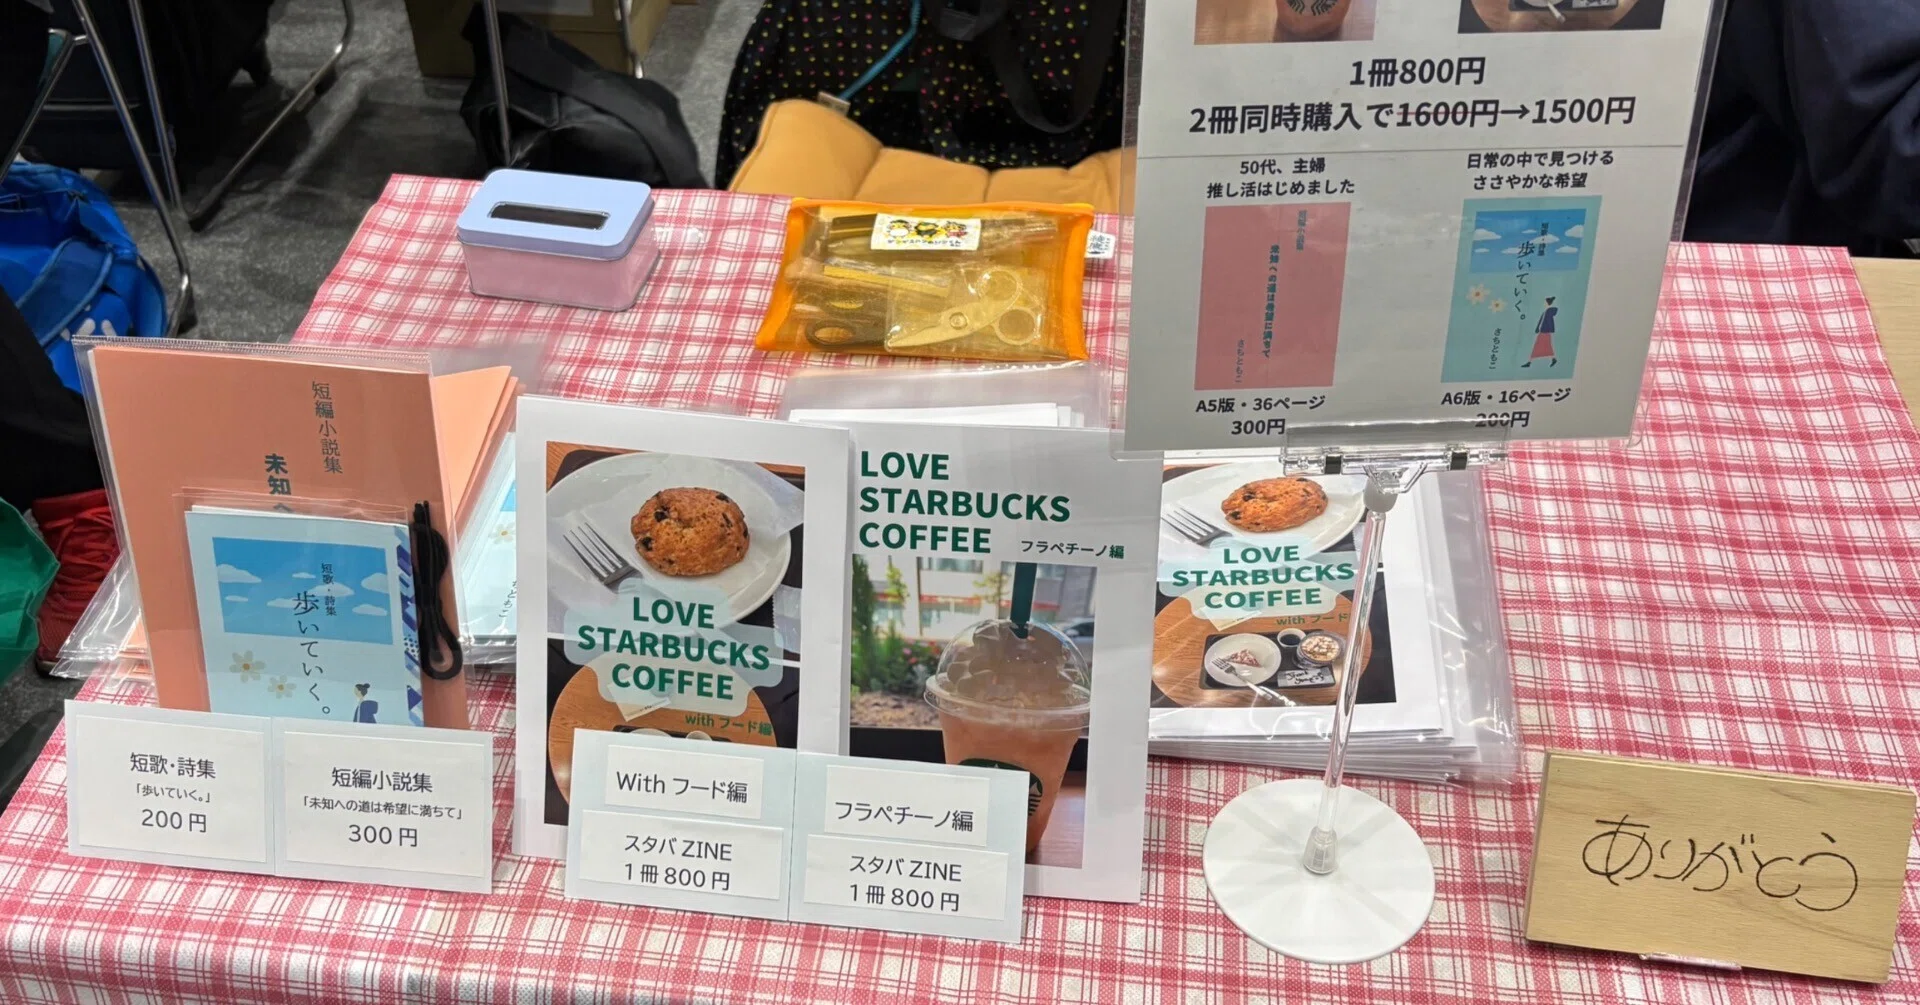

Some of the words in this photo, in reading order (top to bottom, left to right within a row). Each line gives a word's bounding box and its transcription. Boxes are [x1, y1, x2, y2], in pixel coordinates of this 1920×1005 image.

[1349, 57, 1486, 88] 1冊800円
[1239, 157, 1326, 176] 50代、主婦
[1467, 150, 1614, 170] 日常の中で見つける
[1206, 178, 1355, 199] 推し活はじめました
[1473, 172, 1588, 191] ささやかな希望
[1512, 240, 1536, 321] 歩いていく。
[1488, 327, 1503, 370] さちともこ
[1195, 395, 1326, 413] A5版・36ページ
[1440, 387, 1572, 406] A6版・16ページ
[311, 380, 343, 474] 短編小説集
[1230, 418, 1286, 436] 300円
[1474, 410, 1531, 429] 200円
[860, 450, 950, 481] LOVE
[859, 486, 1071, 523] STARBUCKS
[859, 522, 992, 554] COFFEE
[1021, 540, 1125, 560] フラペチーノ編
[1223, 545, 1300, 565] LOVE
[1172, 563, 1355, 587] STARBUCKS
[1204, 588, 1322, 609] COFFEE
[632, 596, 715, 629] LOVE
[1276, 614, 1305, 626] with
[1311, 611, 1351, 625] フード
[291, 590, 332, 715] 歩いていく。
[577, 625, 771, 671] STARBUCKS
[611, 662, 734, 701] COFFEE
[685, 712, 715, 728] with
[130, 752, 216, 780] 短歌・詩集
[331, 766, 433, 793] 短編小説集
[136, 782, 211, 804] 「歩いていく。」
[616, 771, 666, 794] With
[672, 777, 748, 803] フード編
[303, 796, 462, 820] 「未知への道は希望に満ちて」
[835, 801, 974, 833] フラペチーノ編
[624, 834, 676, 855] スタバ
[682, 839, 733, 862] ZINE
[849, 855, 904, 876] スタバ
[908, 860, 962, 882] ZINE
[1582, 814, 1859, 912] ありがとう
